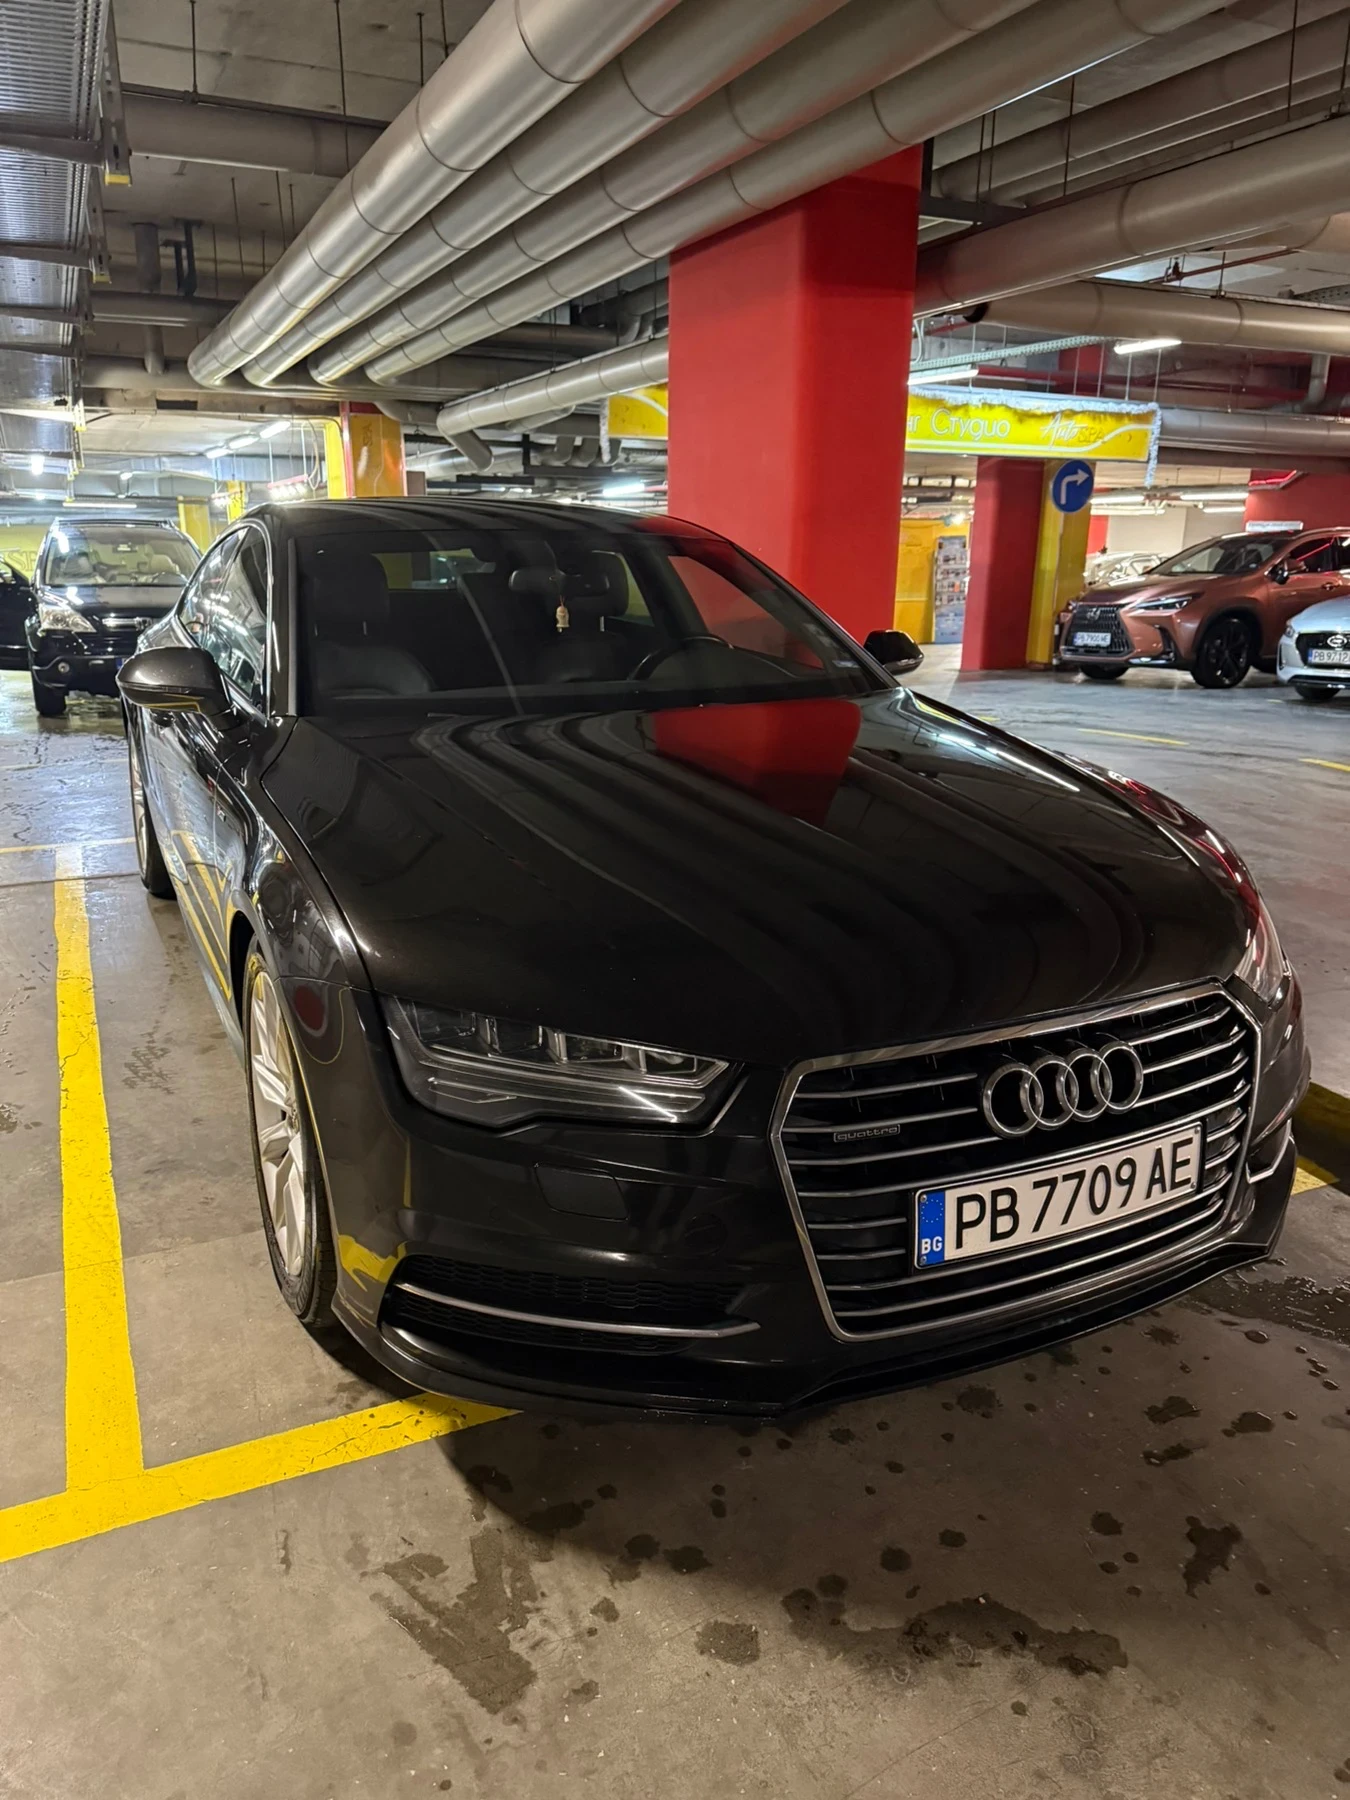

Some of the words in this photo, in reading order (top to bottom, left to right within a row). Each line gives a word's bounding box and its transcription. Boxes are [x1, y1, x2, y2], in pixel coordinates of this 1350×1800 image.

[1040, 411, 1088, 449] Auto
[836, 1126, 899, 1141] quattro
[956, 1187, 1020, 1250] PB
[1031, 1157, 1137, 1233] 7709
[1145, 1137, 1194, 1200] AE
[921, 1237, 943, 1255] BG
